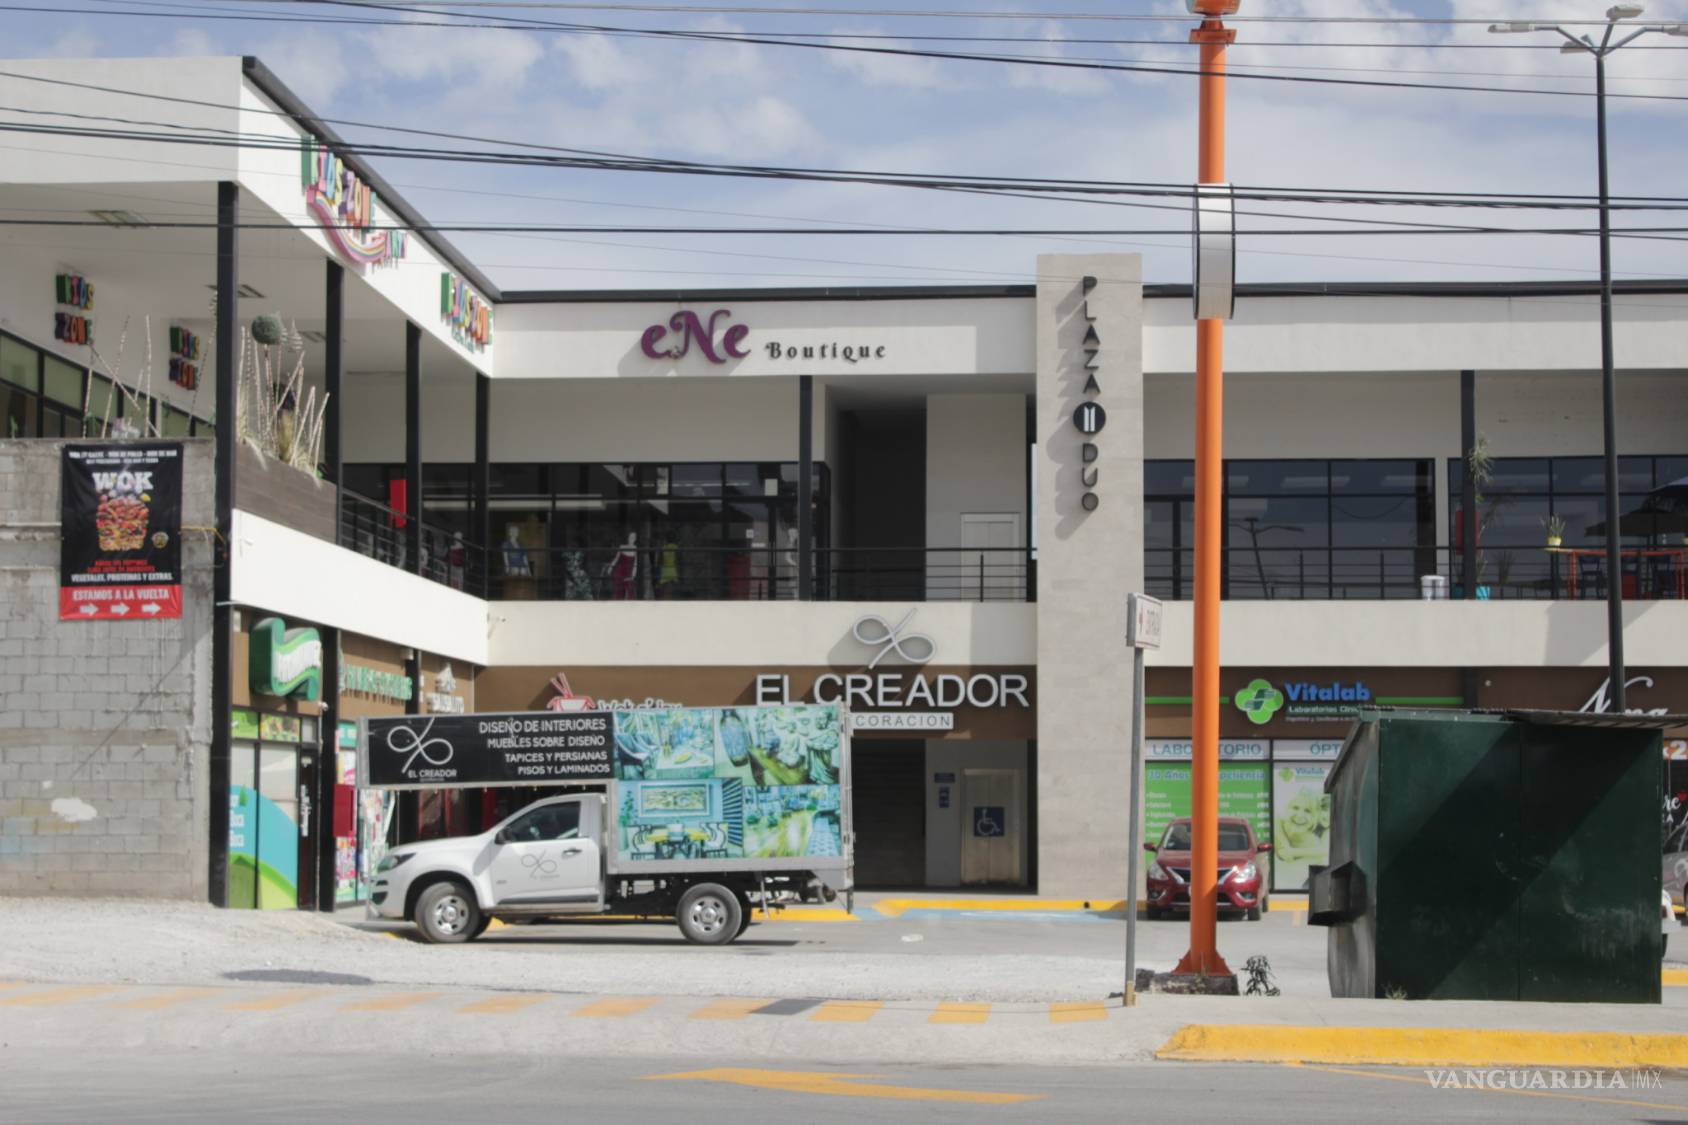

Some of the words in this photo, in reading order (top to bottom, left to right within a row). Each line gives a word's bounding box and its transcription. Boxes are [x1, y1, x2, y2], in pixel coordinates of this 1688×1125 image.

[1082, 275, 1102, 394] PLAZA
[764, 341, 887, 363] Boutique
[92, 472, 154, 493] WOK
[1081, 442, 1100, 512] DUO
[73, 590, 112, 600] ESTAMOS
[115, 590, 121, 600] A
[123, 590, 135, 600] LA
[137, 589, 169, 600] VUELTA
[756, 674, 805, 706] EL
[813, 673, 1029, 707] CREADOR
[1284, 681, 1371, 701] Vitalab
[524, 720, 539, 732] DE
[541, 719, 607, 732] INTERIORES
[854, 715, 950, 727] CORACION
[487, 737, 532, 748] MUEBLES
[533, 736, 565, 747] SOBRE
[505, 752, 545, 763] TAPICES
[546, 753, 553, 761] Y
[554, 751, 607, 761] PERSIANAS
[408, 770, 417, 778] EL
[419, 769, 457, 778] CREADOR
[518, 766, 545, 775] PISOS
[546, 766, 553, 774] Y
[554, 764, 610, 774] LAMINADOS
